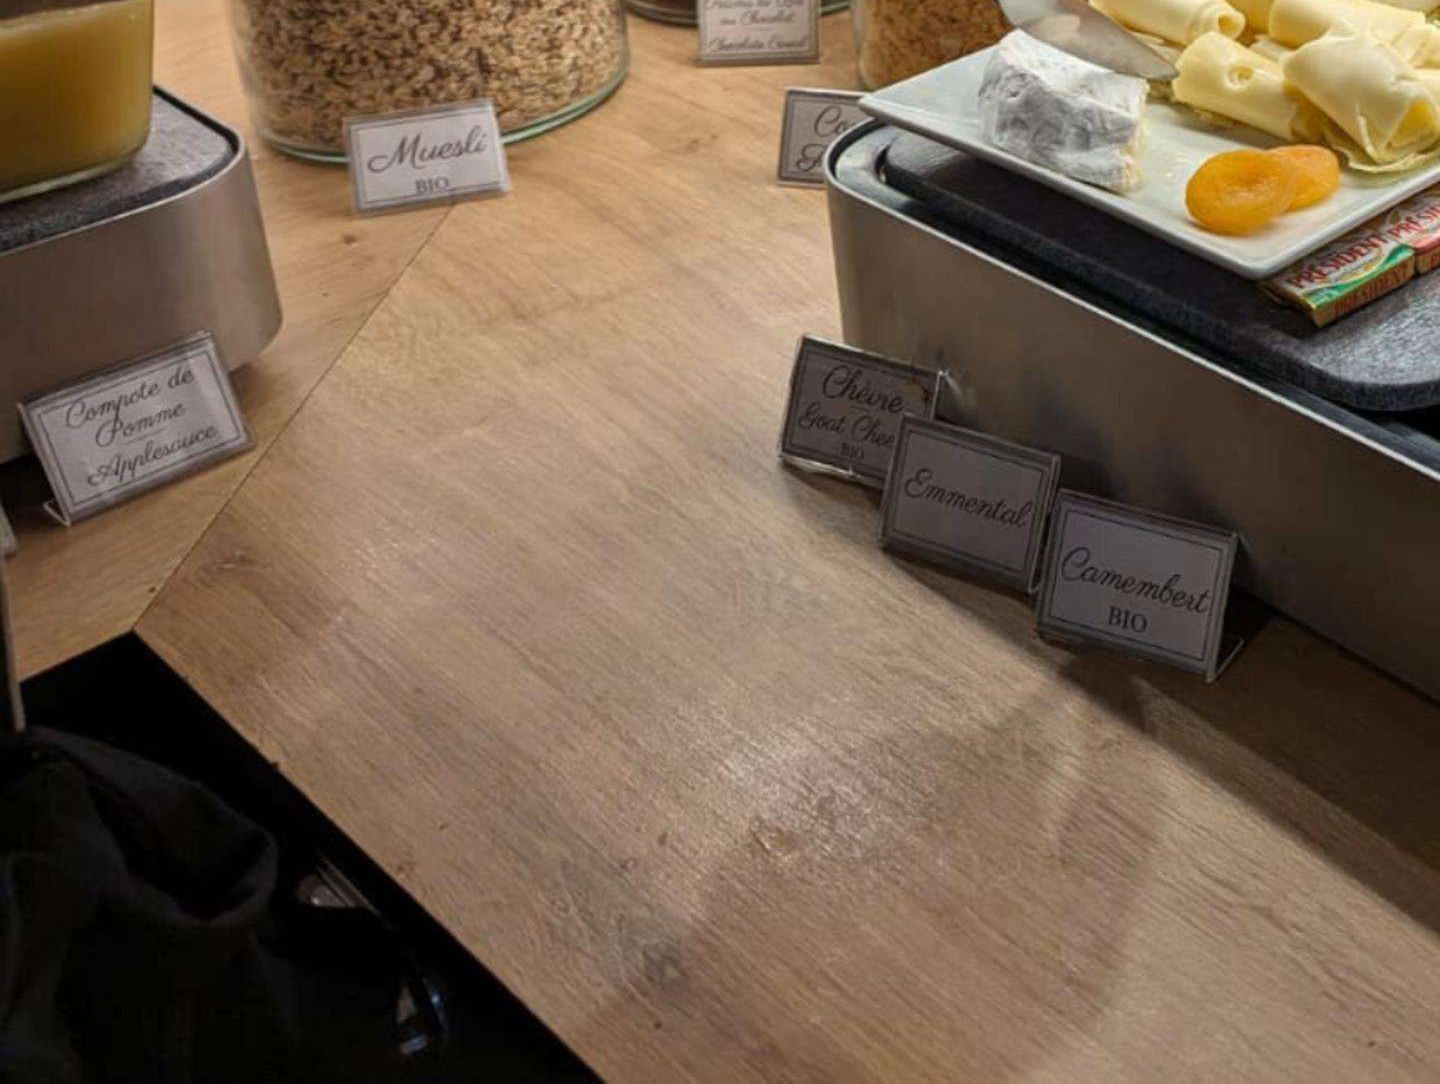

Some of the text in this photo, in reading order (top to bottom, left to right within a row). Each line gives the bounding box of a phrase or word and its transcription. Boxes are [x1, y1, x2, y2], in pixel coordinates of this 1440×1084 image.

[367, 125, 488, 173] Muesli
[415, 176, 449, 196] BIO
[65, 366, 195, 429] Compote de
[95, 402, 188, 447] Pomme
[797, 401, 896, 447] Goat Chee
[87, 424, 219, 486] Applesauce
[903, 467, 1035, 529] Emmental
[1061, 546, 1211, 614] Camembert
[1107, 606, 1149, 634] BIO
